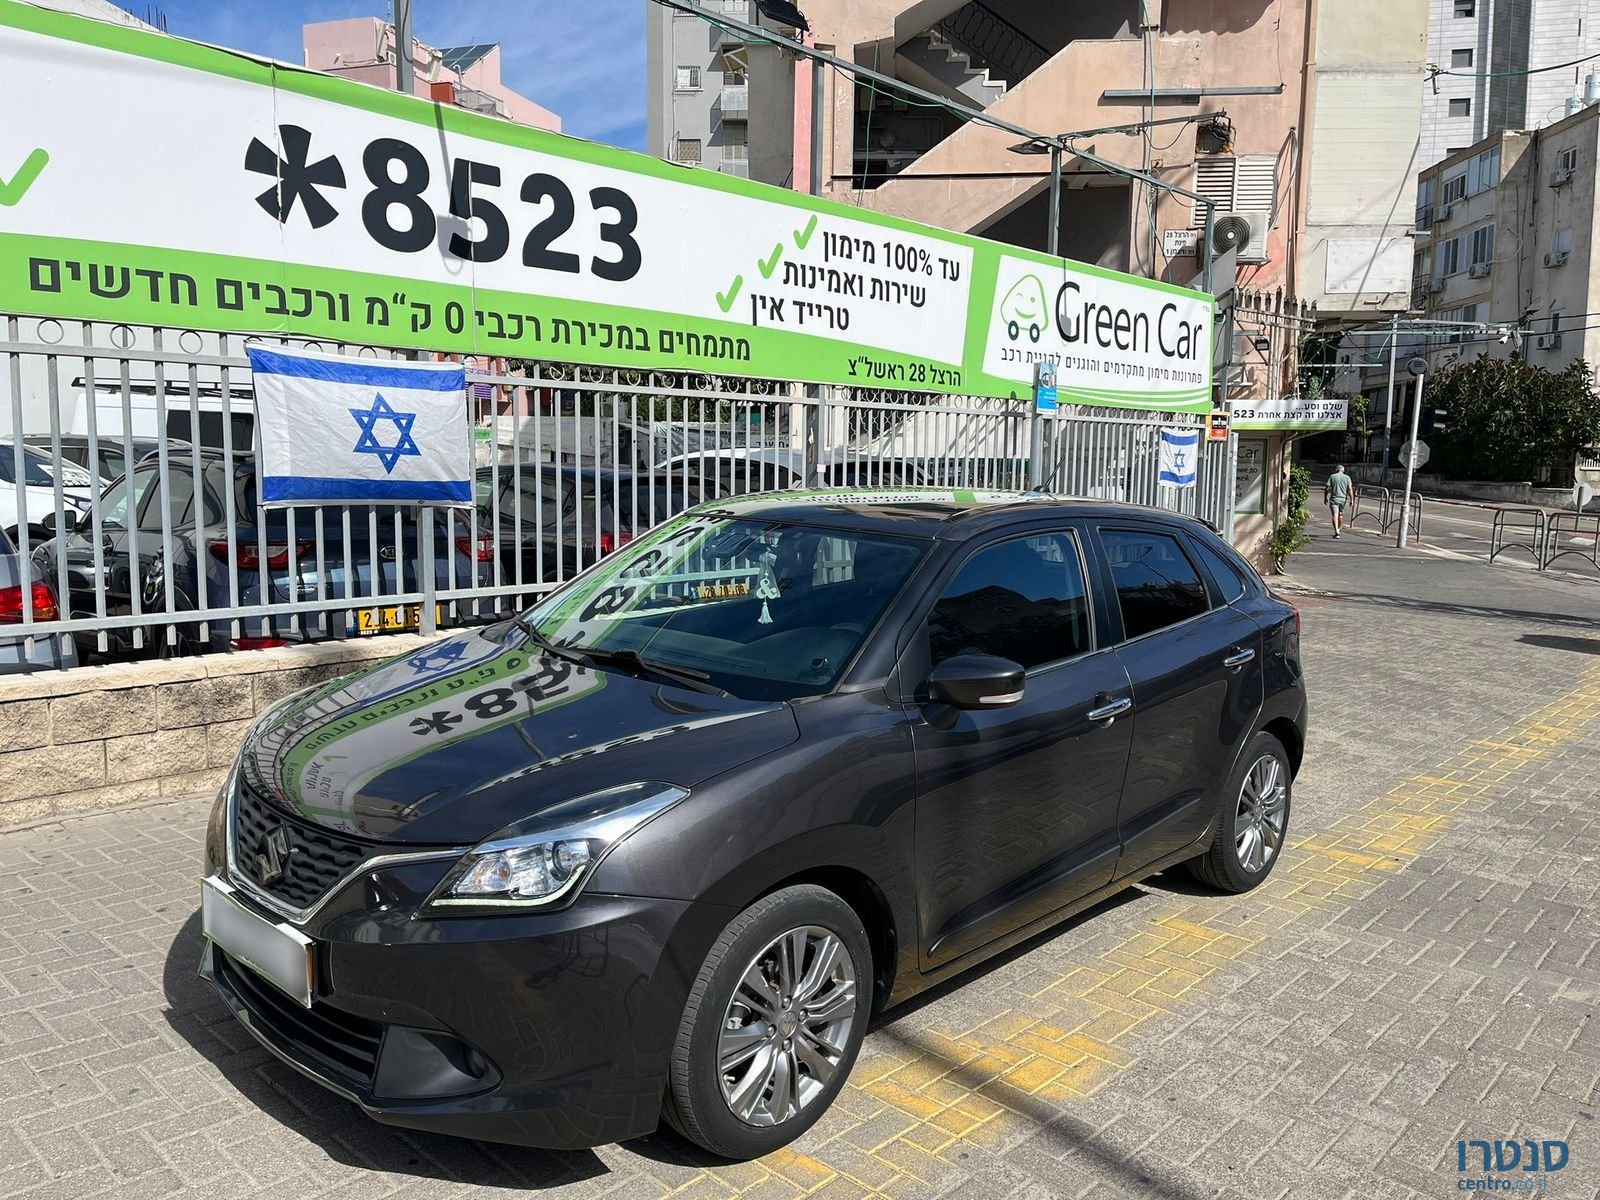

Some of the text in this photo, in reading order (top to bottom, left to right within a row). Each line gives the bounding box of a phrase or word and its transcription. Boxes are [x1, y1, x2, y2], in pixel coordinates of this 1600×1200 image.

[823, 231, 961, 282] עד 100% מימון
[29, 257, 198, 306] חדשים
[783, 261, 926, 308] שירות ואמינות
[216, 278, 350, 322] ורכבים
[445, 301, 465, 334] 0
[750, 294, 850, 331] טרייד אין
[1055, 281, 1203, 361] Green Car
[475, 309, 542, 341] רכבי
[551, 317, 651, 352] במכירת
[659, 330, 751, 361] מתמחים
[1001, 347, 1022, 364] רכב
[909, 363, 926, 382] 28
[929, 364, 961, 387] הרצל
[1065, 356, 1100, 373] והוגנים
[1104, 360, 1145, 379] מתקדמים
[1148, 366, 1169, 381] מימון
[1172, 370, 1203, 384] פתרונות
[1257, 411, 1281, 419] אחרת
[1305, 411, 1315, 419] זה
[1317, 411, 1343, 419] אצלנו
[1322, 403, 1343, 411] שלם
